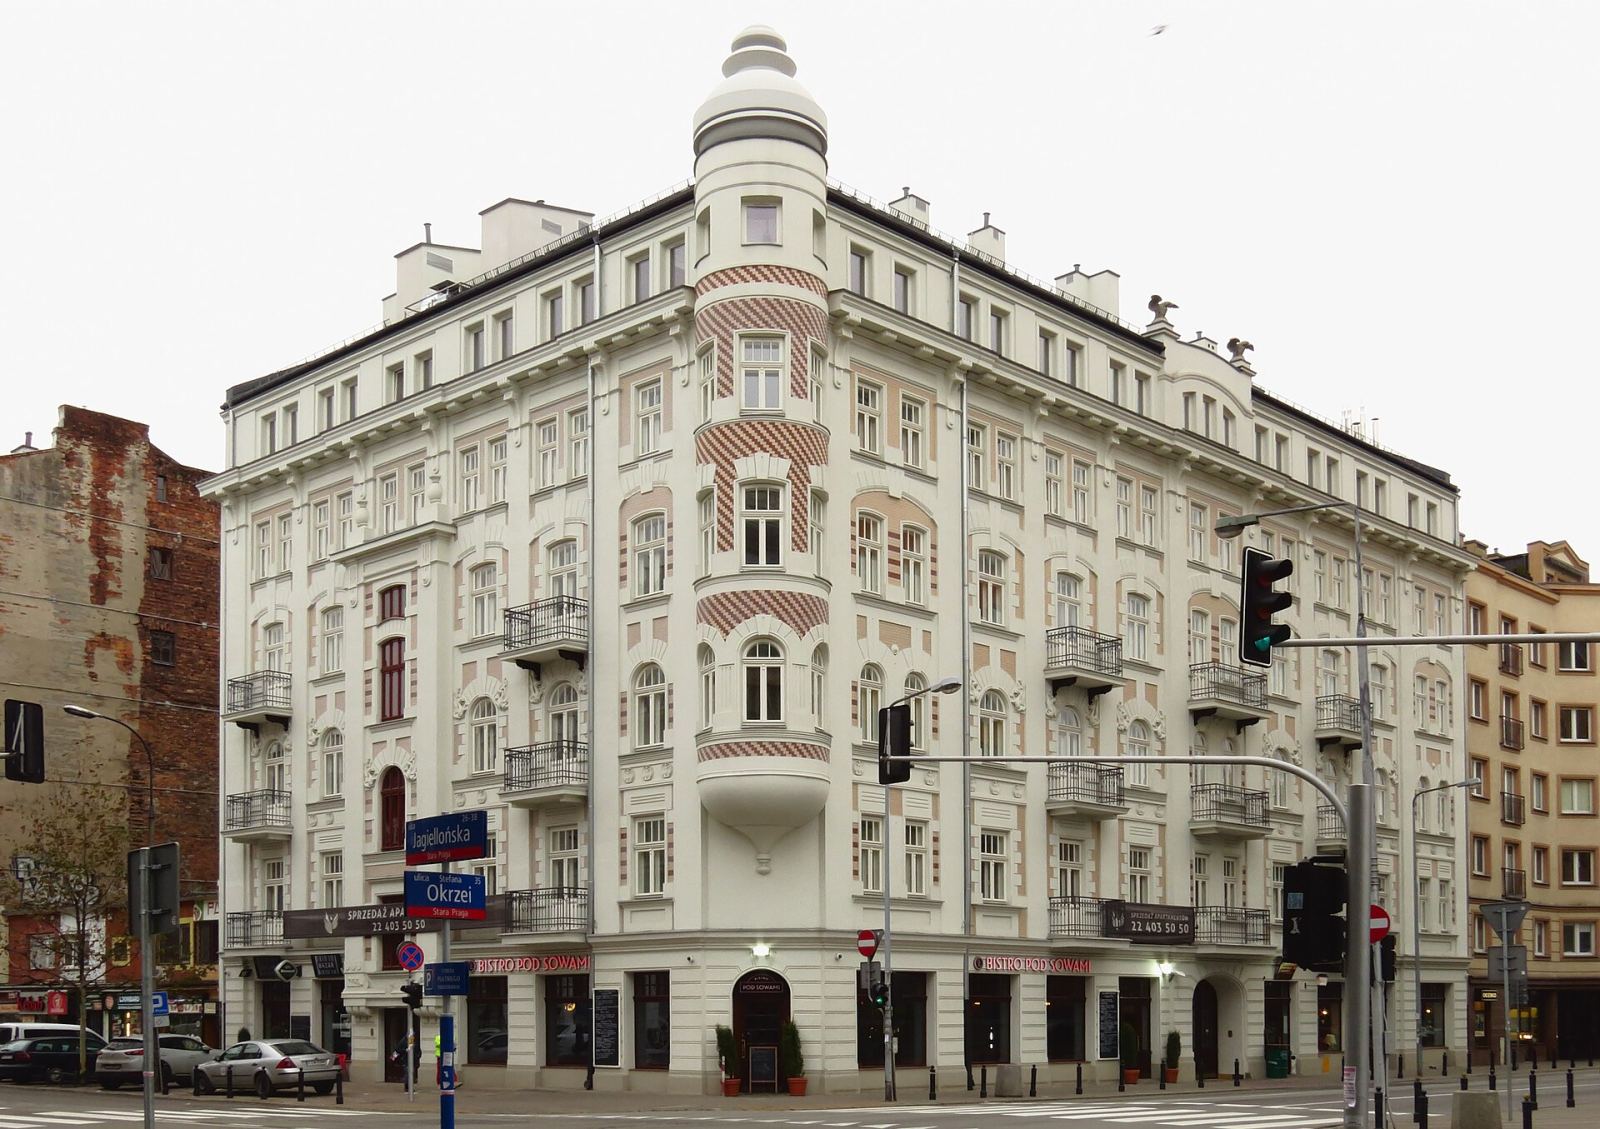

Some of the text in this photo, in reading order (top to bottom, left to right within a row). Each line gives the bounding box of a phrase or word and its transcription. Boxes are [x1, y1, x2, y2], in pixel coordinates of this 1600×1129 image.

[412, 824, 471, 852] Jagiellońska
[413, 873, 462, 884] ulica Stefana
[474, 876, 482, 885] 35
[427, 883, 472, 904] Okrzei
[347, 907, 387, 920] SPRZEDAŻ
[432, 907, 469, 918] Stara Praga
[372, 919, 426, 932] 22 403 50 50
[1131, 920, 1189, 934] 22 403 50 50
[479, 955, 591, 973] BISTRO POD SOWAMI
[985, 956, 1092, 973] BISTRO POD SOWAMI
